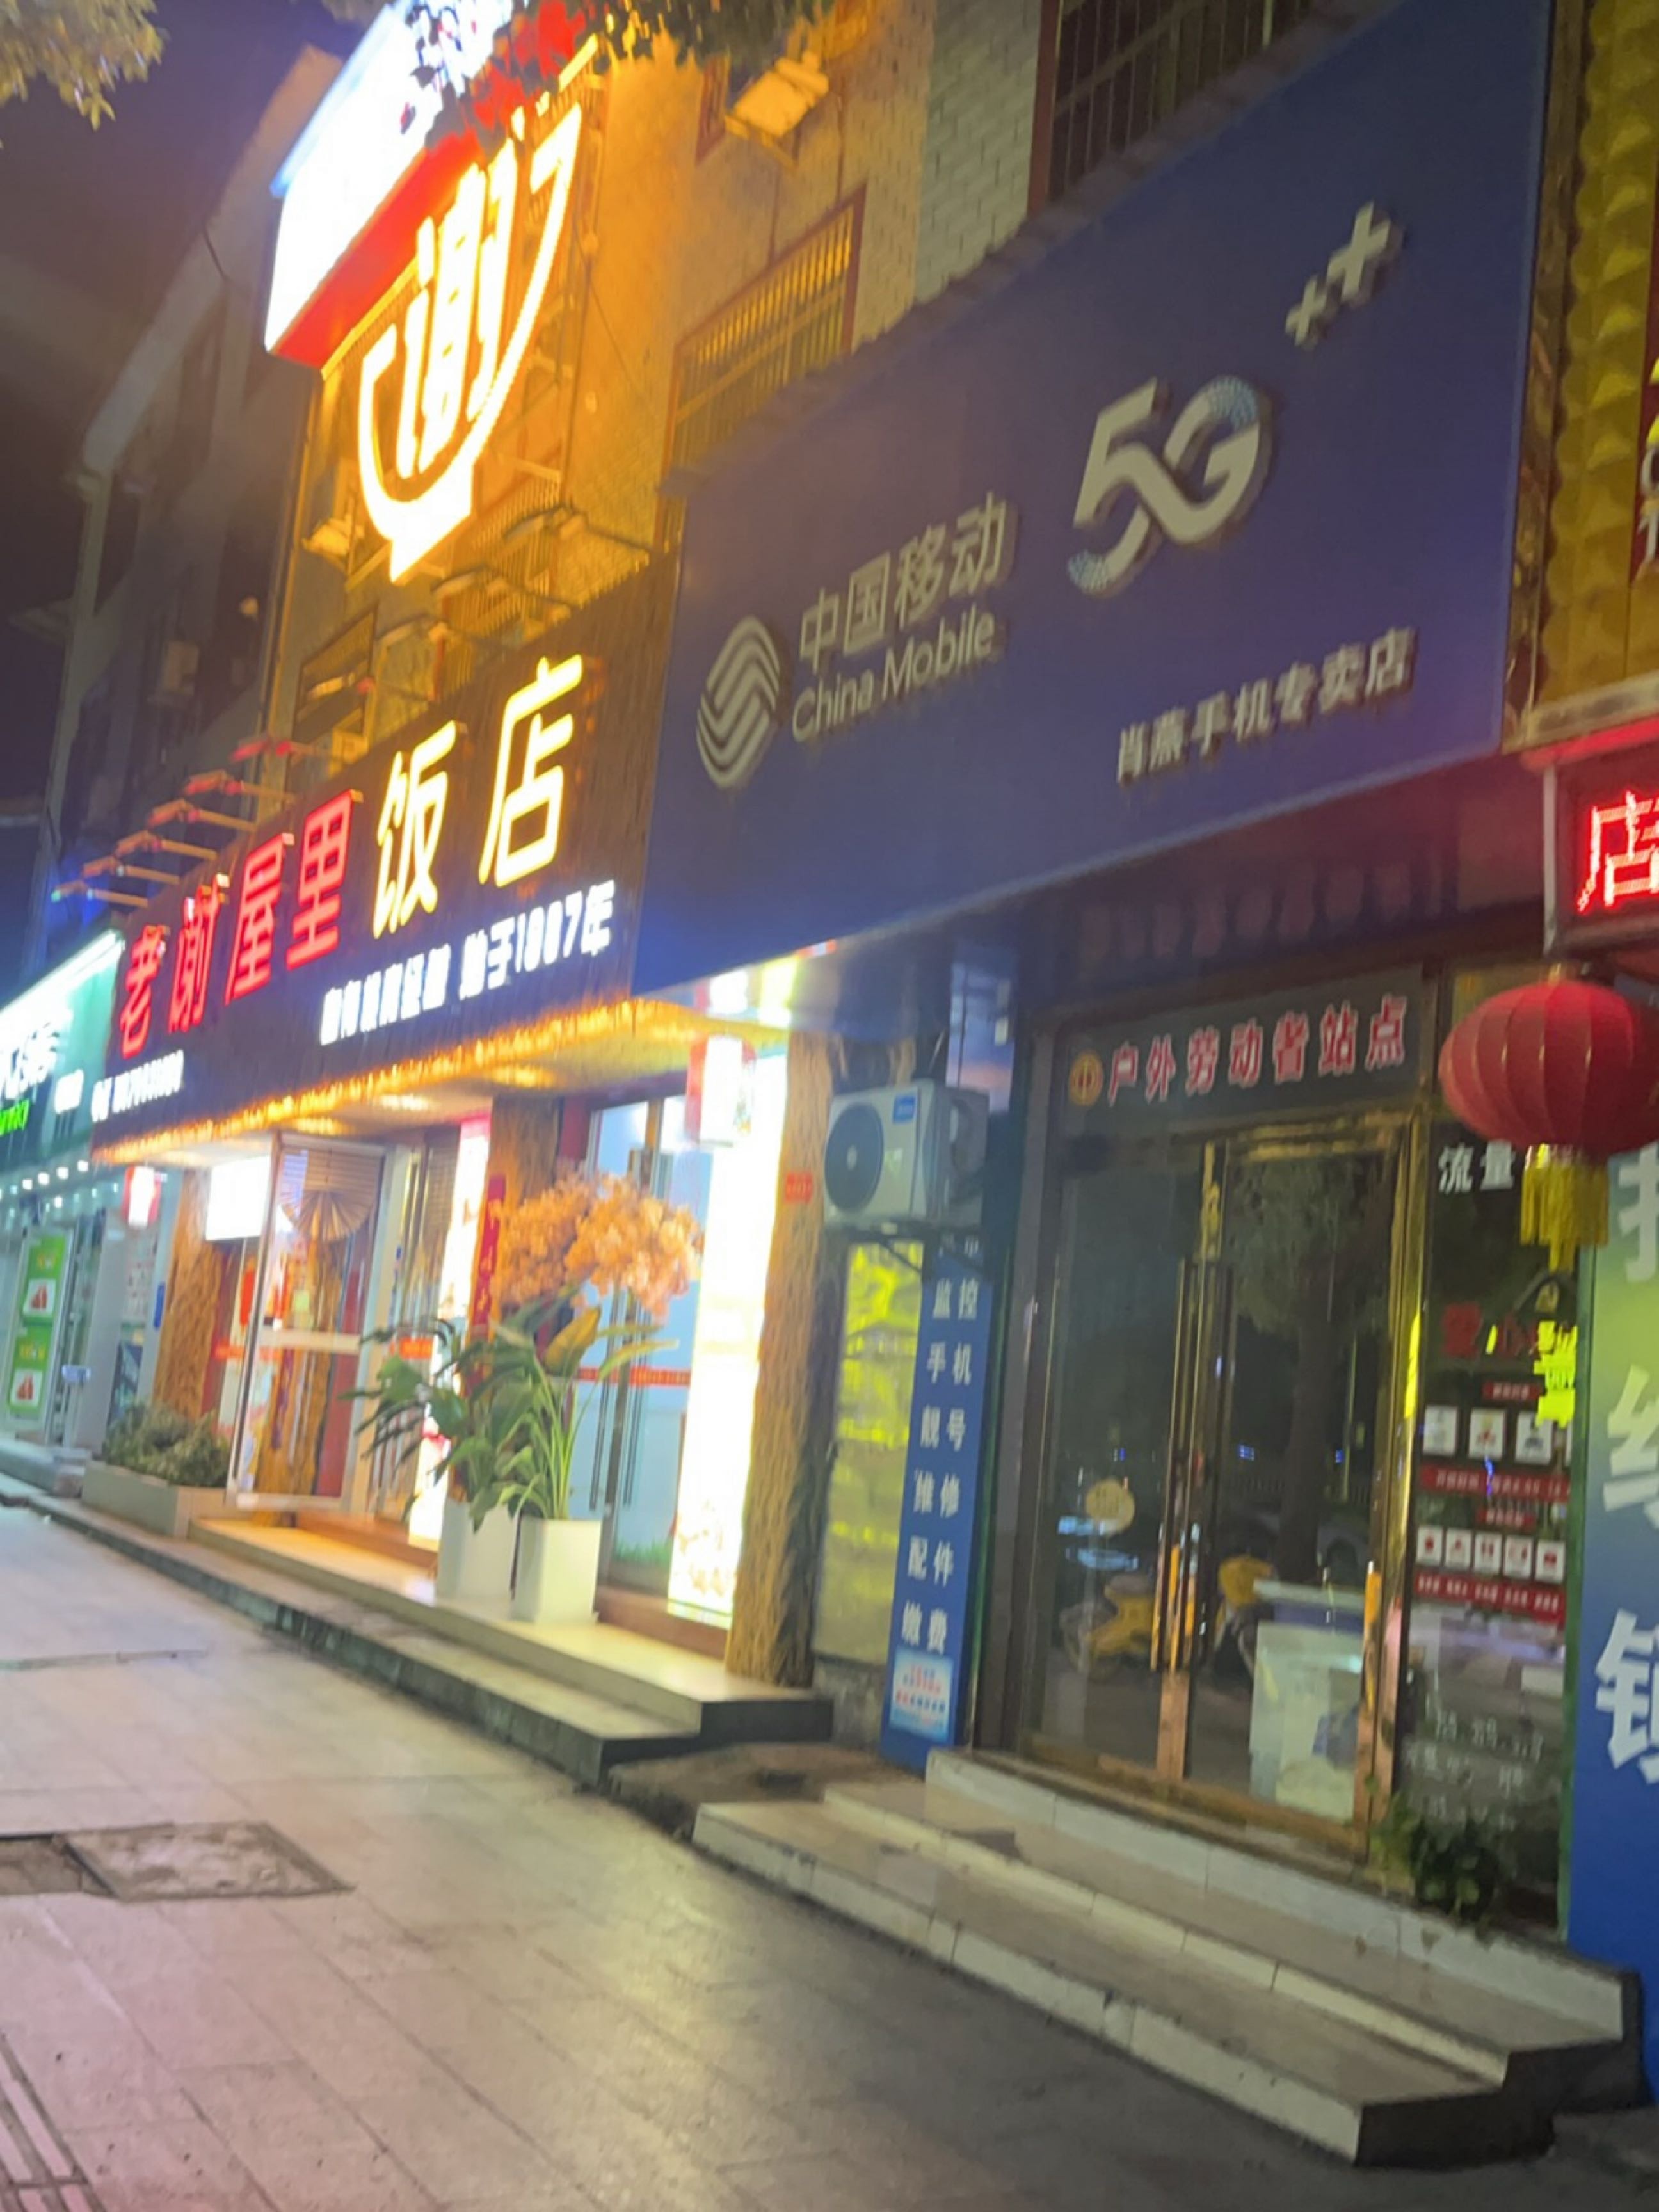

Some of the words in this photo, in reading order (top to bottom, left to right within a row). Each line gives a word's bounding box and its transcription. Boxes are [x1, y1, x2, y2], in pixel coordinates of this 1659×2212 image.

[1068, 374, 1261, 592] 5G
[799, 491, 1009, 675] 中国移动
[792, 669, 874, 742] China
[882, 602, 996, 703] Mobile
[1108, 993, 1407, 1107] 户外劳动者站点
